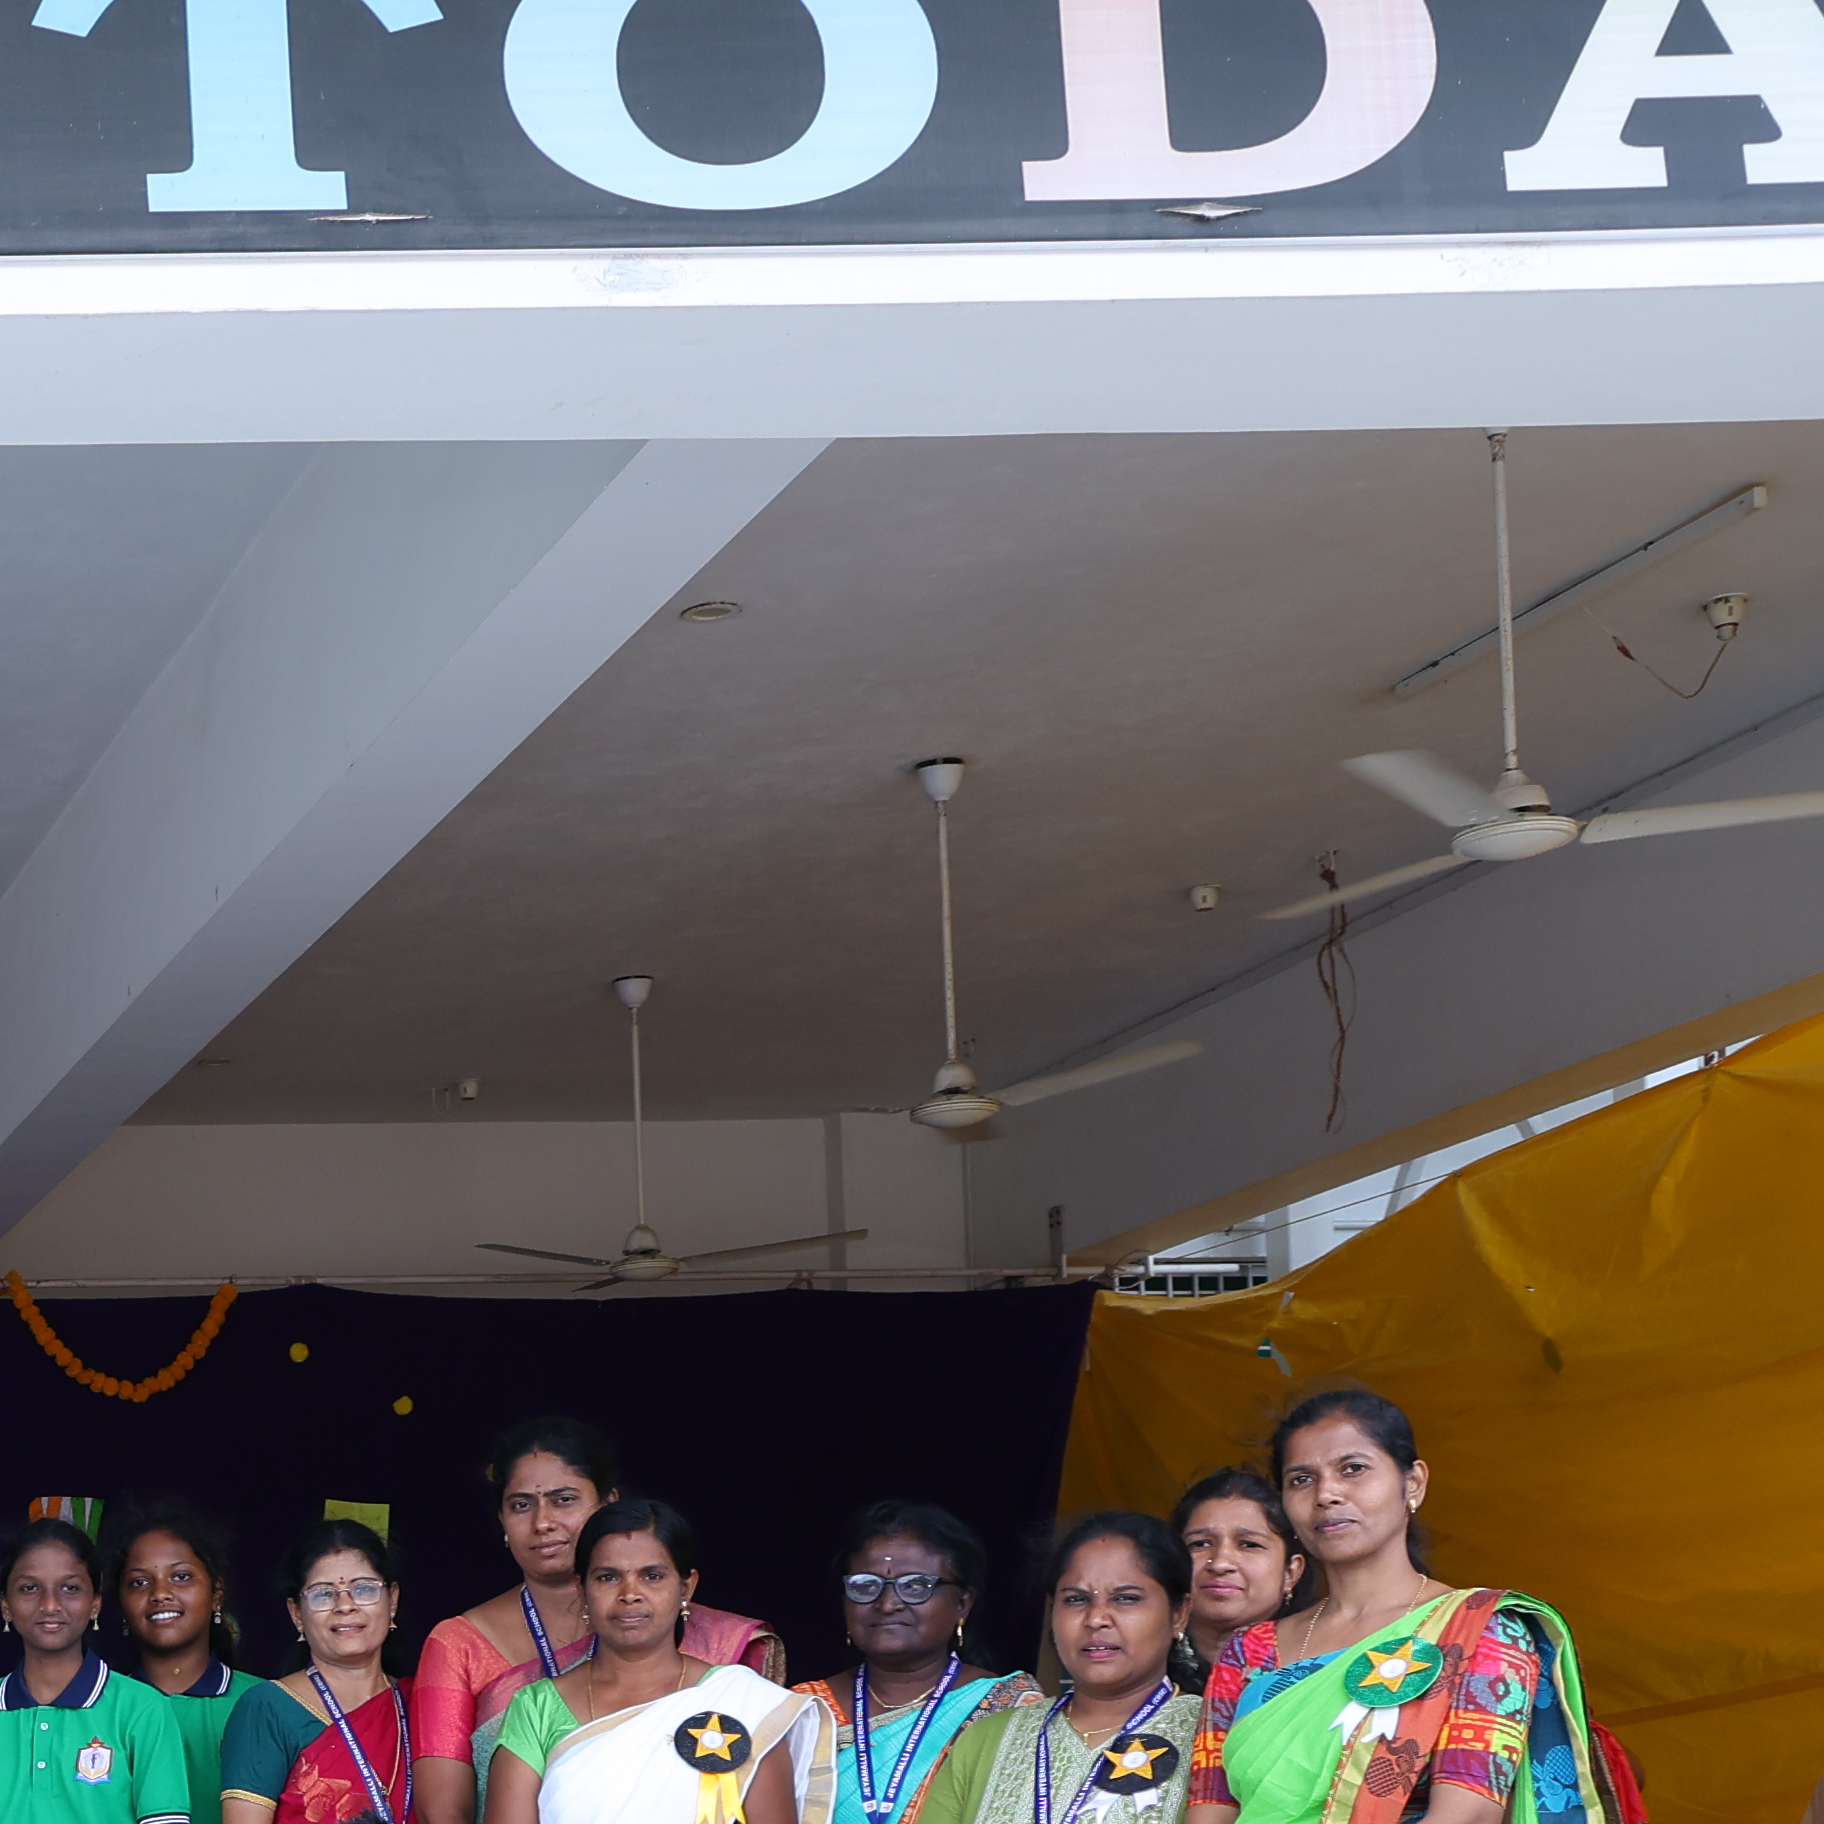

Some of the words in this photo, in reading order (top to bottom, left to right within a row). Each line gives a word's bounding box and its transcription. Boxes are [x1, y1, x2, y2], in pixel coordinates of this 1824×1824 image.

[528, 1607, 543, 1636] SCHOOL
[538, 1636, 558, 1677] RNATIONAL
[322, 1690, 341, 1719] SCHOOL
[1125, 1701, 1154, 1730] SCHOOL
[337, 1718, 370, 1778] INTERNATIONAL
[885, 1752, 909, 1798] JEYAMALLI
[904, 1696, 938, 1752] INTERNATIONAL
[858, 1752, 871, 1797] JEYAMALLI
